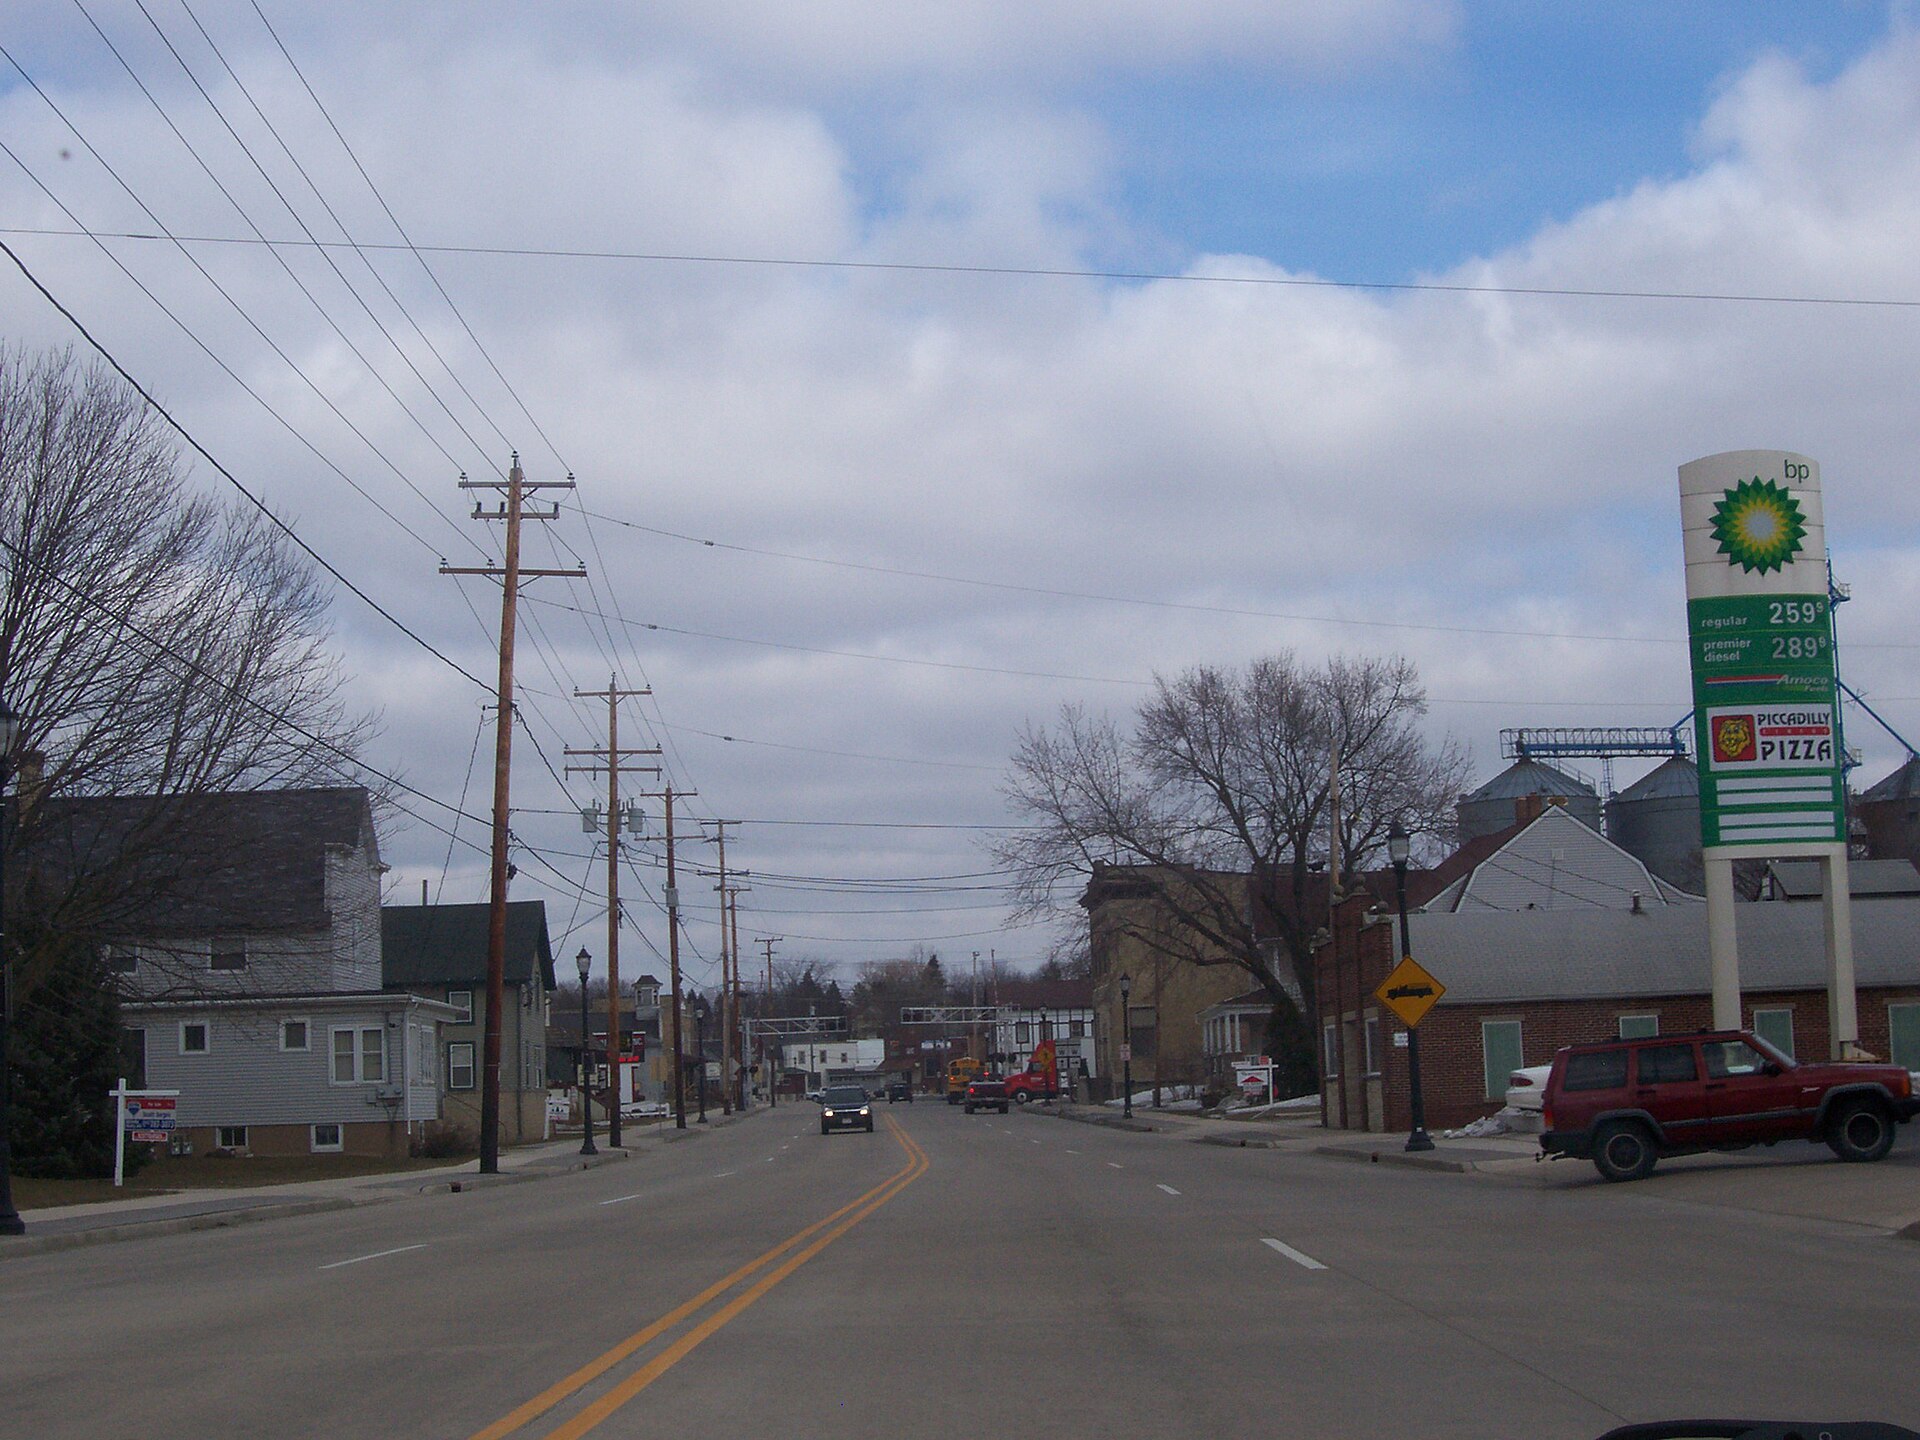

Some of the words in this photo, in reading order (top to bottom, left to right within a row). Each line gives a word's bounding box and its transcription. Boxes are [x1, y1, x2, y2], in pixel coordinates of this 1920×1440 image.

[1784, 459, 1810, 484] bp
[1701, 615, 1748, 629] regular
[1703, 637, 1752, 652] premier
[1704, 650, 1741, 663] diesel
[1776, 673, 1829, 685] Amoco
[1757, 711, 1831, 726] PICCADILLY
[1760, 739, 1831, 762] PIZZA
